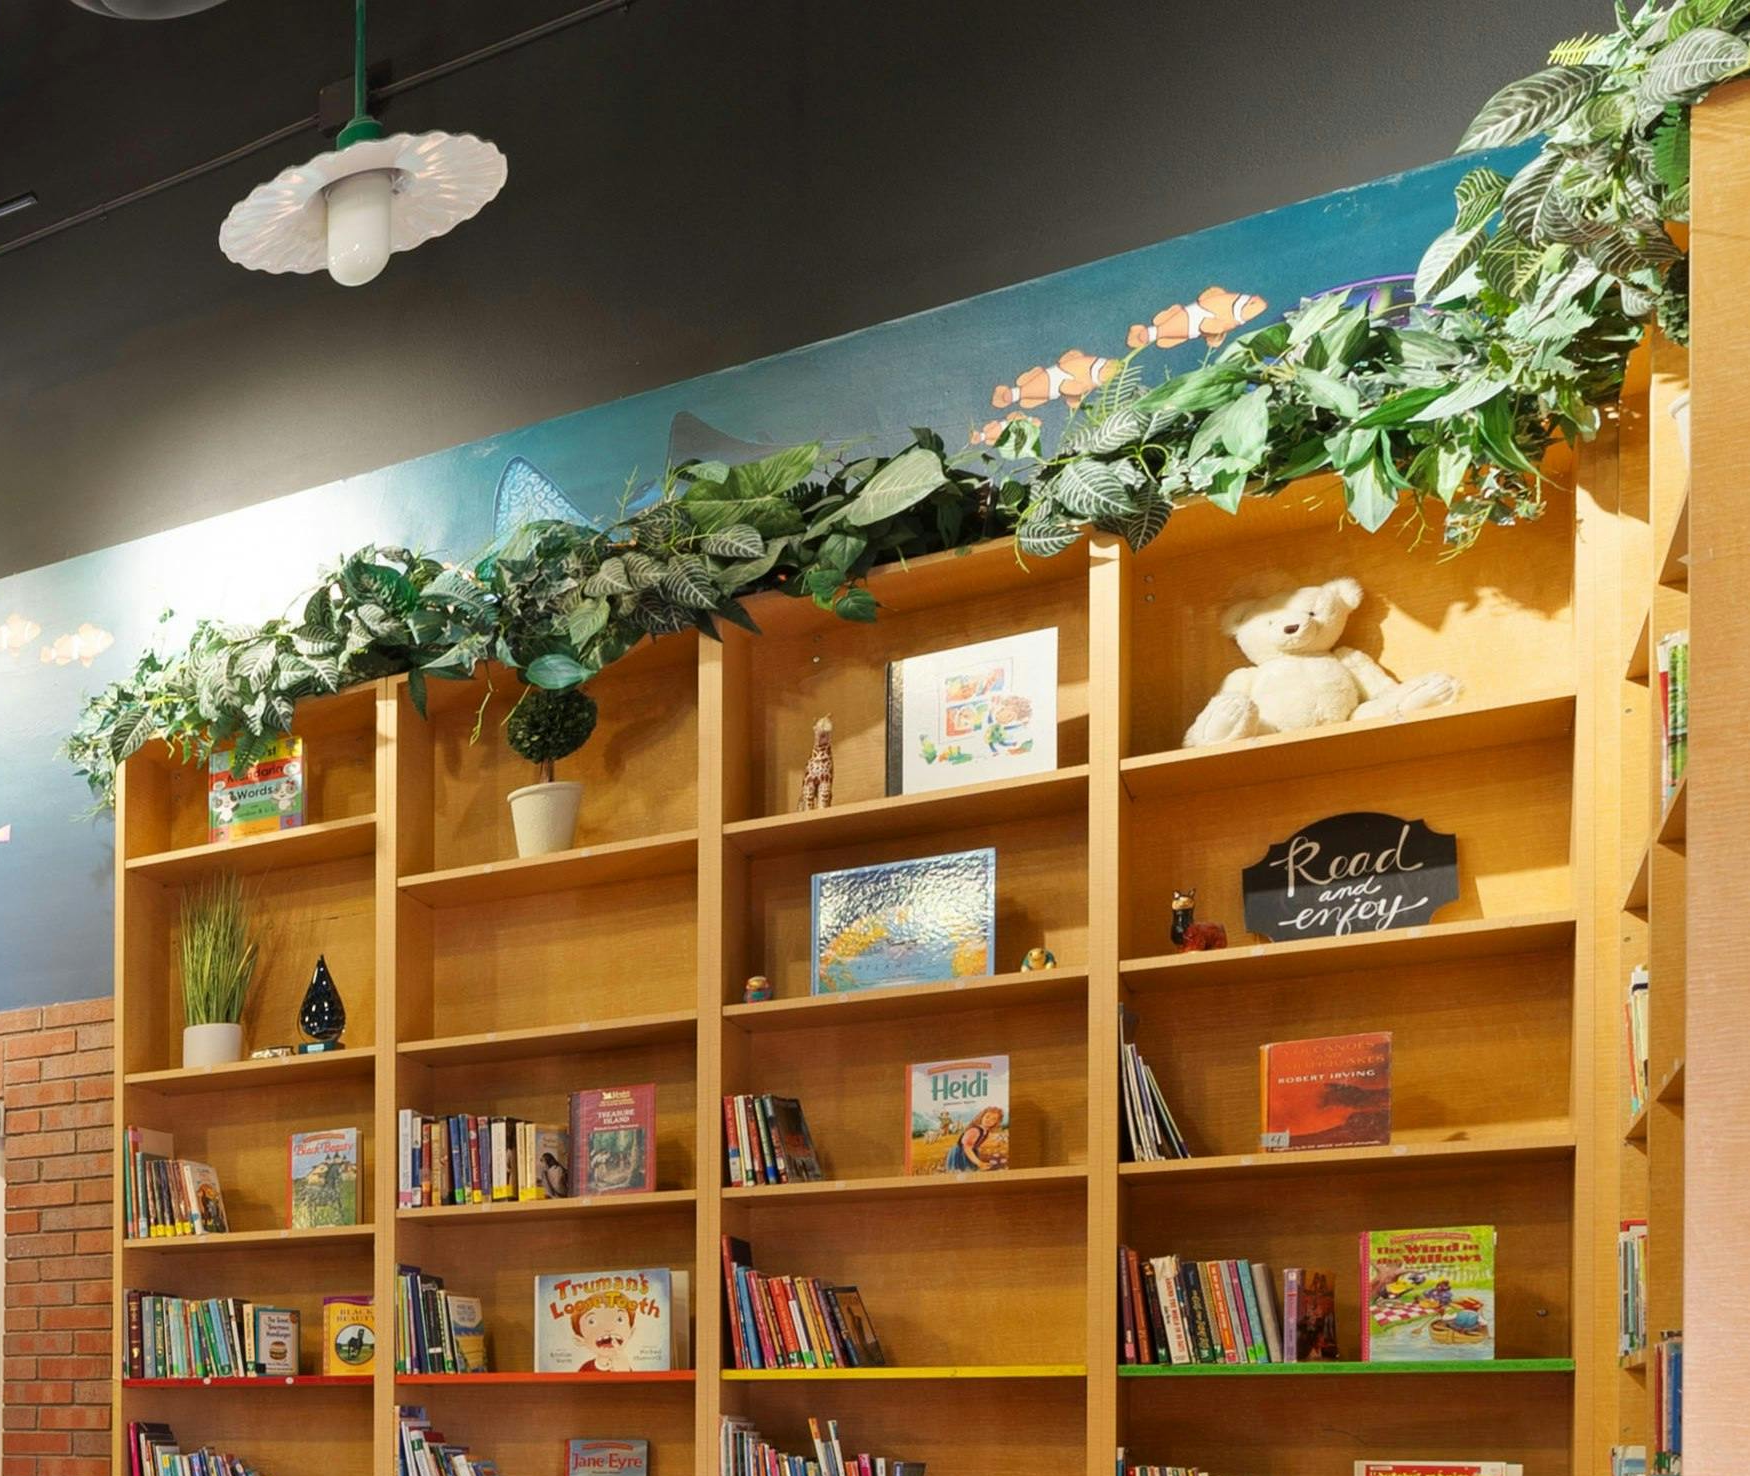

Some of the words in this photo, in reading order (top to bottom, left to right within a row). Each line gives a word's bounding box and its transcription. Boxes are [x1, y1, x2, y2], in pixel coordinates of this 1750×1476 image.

[236, 785, 273, 800] Words
[1269, 824, 1424, 898] Read
[1318, 876, 1382, 903] and
[1278, 895, 1429, 937] enjoy
[931, 1070, 989, 1102] Heidi
[1277, 1073, 1325, 1085] ROBERT
[1330, 1068, 1376, 1080] IRVING
[1403, 1253, 1483, 1264] Willows
[1404, 1242, 1460, 1253] Wind
[554, 1272, 649, 1300] Truman's
[549, 1298, 602, 1320] Loose
[604, 1292, 661, 1319] Tooth
[573, 1452, 605, 1470] Jane
[608, 1453, 643, 1470] Eyre
